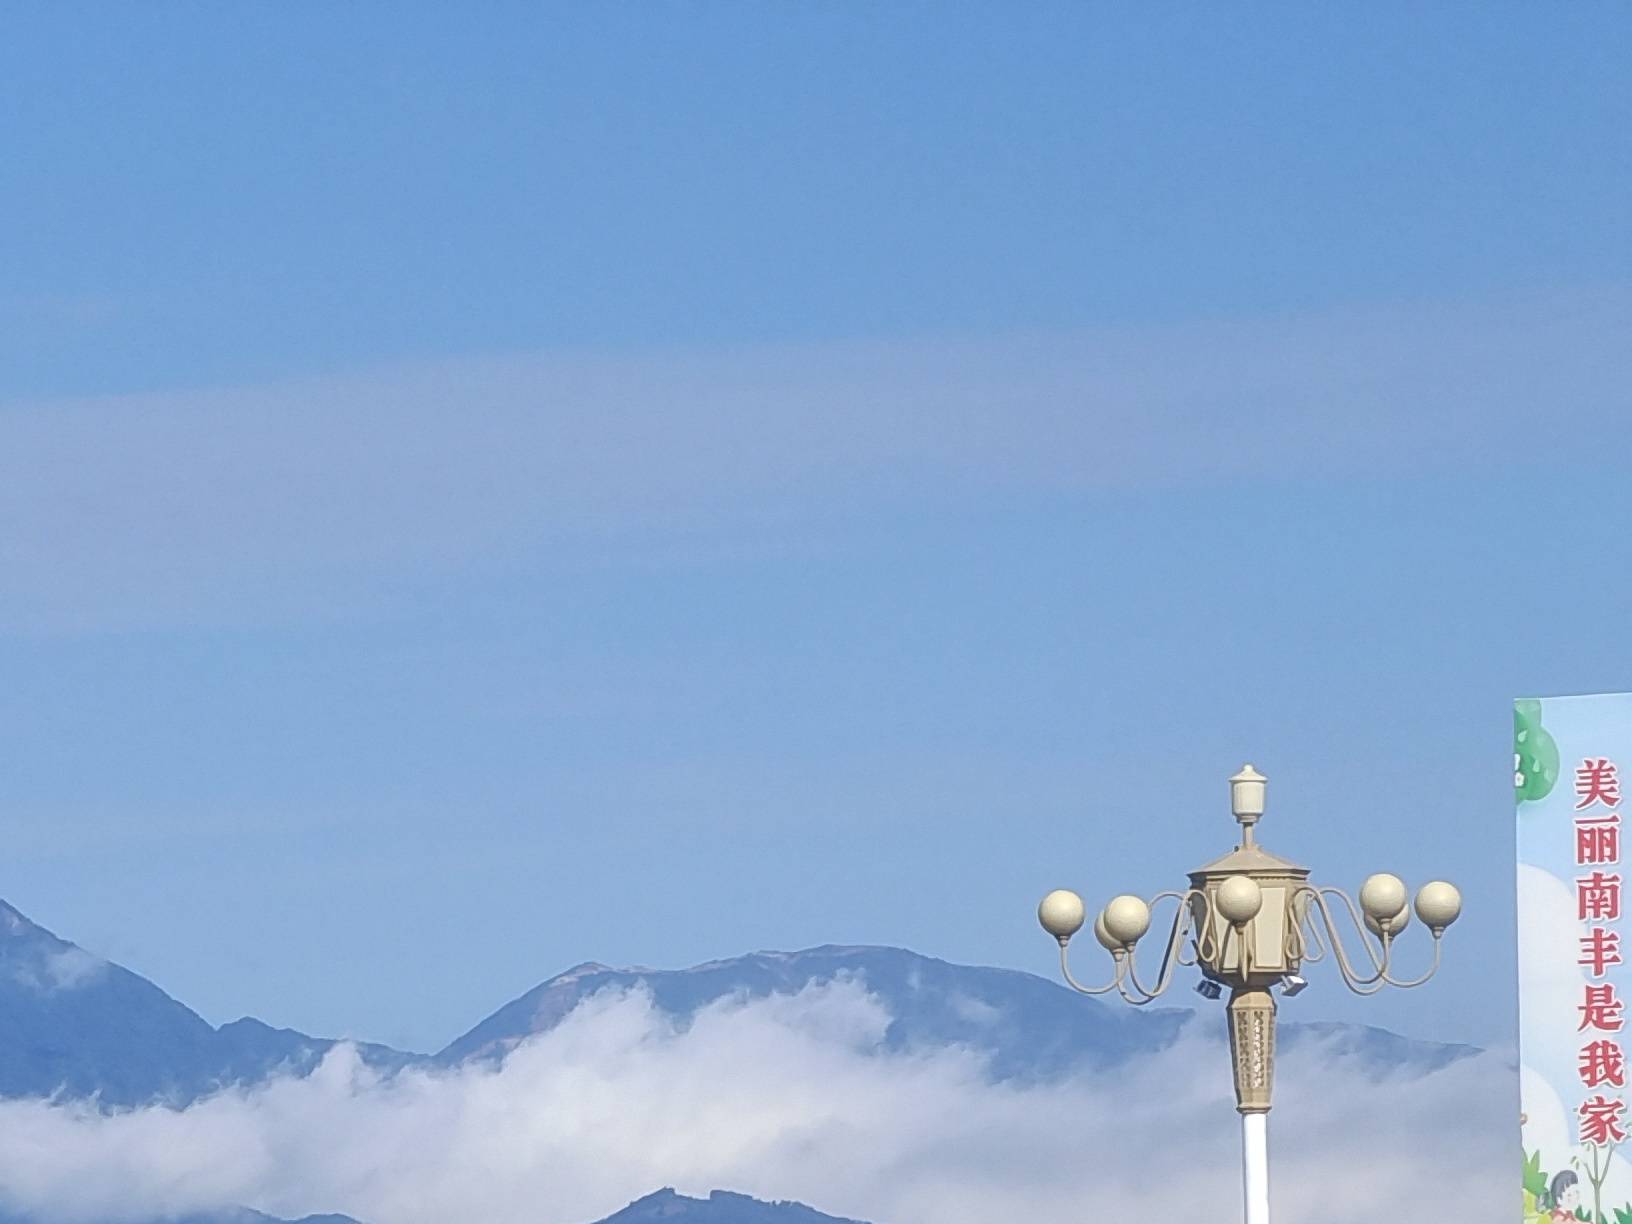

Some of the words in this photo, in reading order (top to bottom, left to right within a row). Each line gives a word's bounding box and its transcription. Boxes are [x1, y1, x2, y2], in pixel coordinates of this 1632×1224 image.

[1575, 759, 1626, 1145] 美丽南丰是我家
